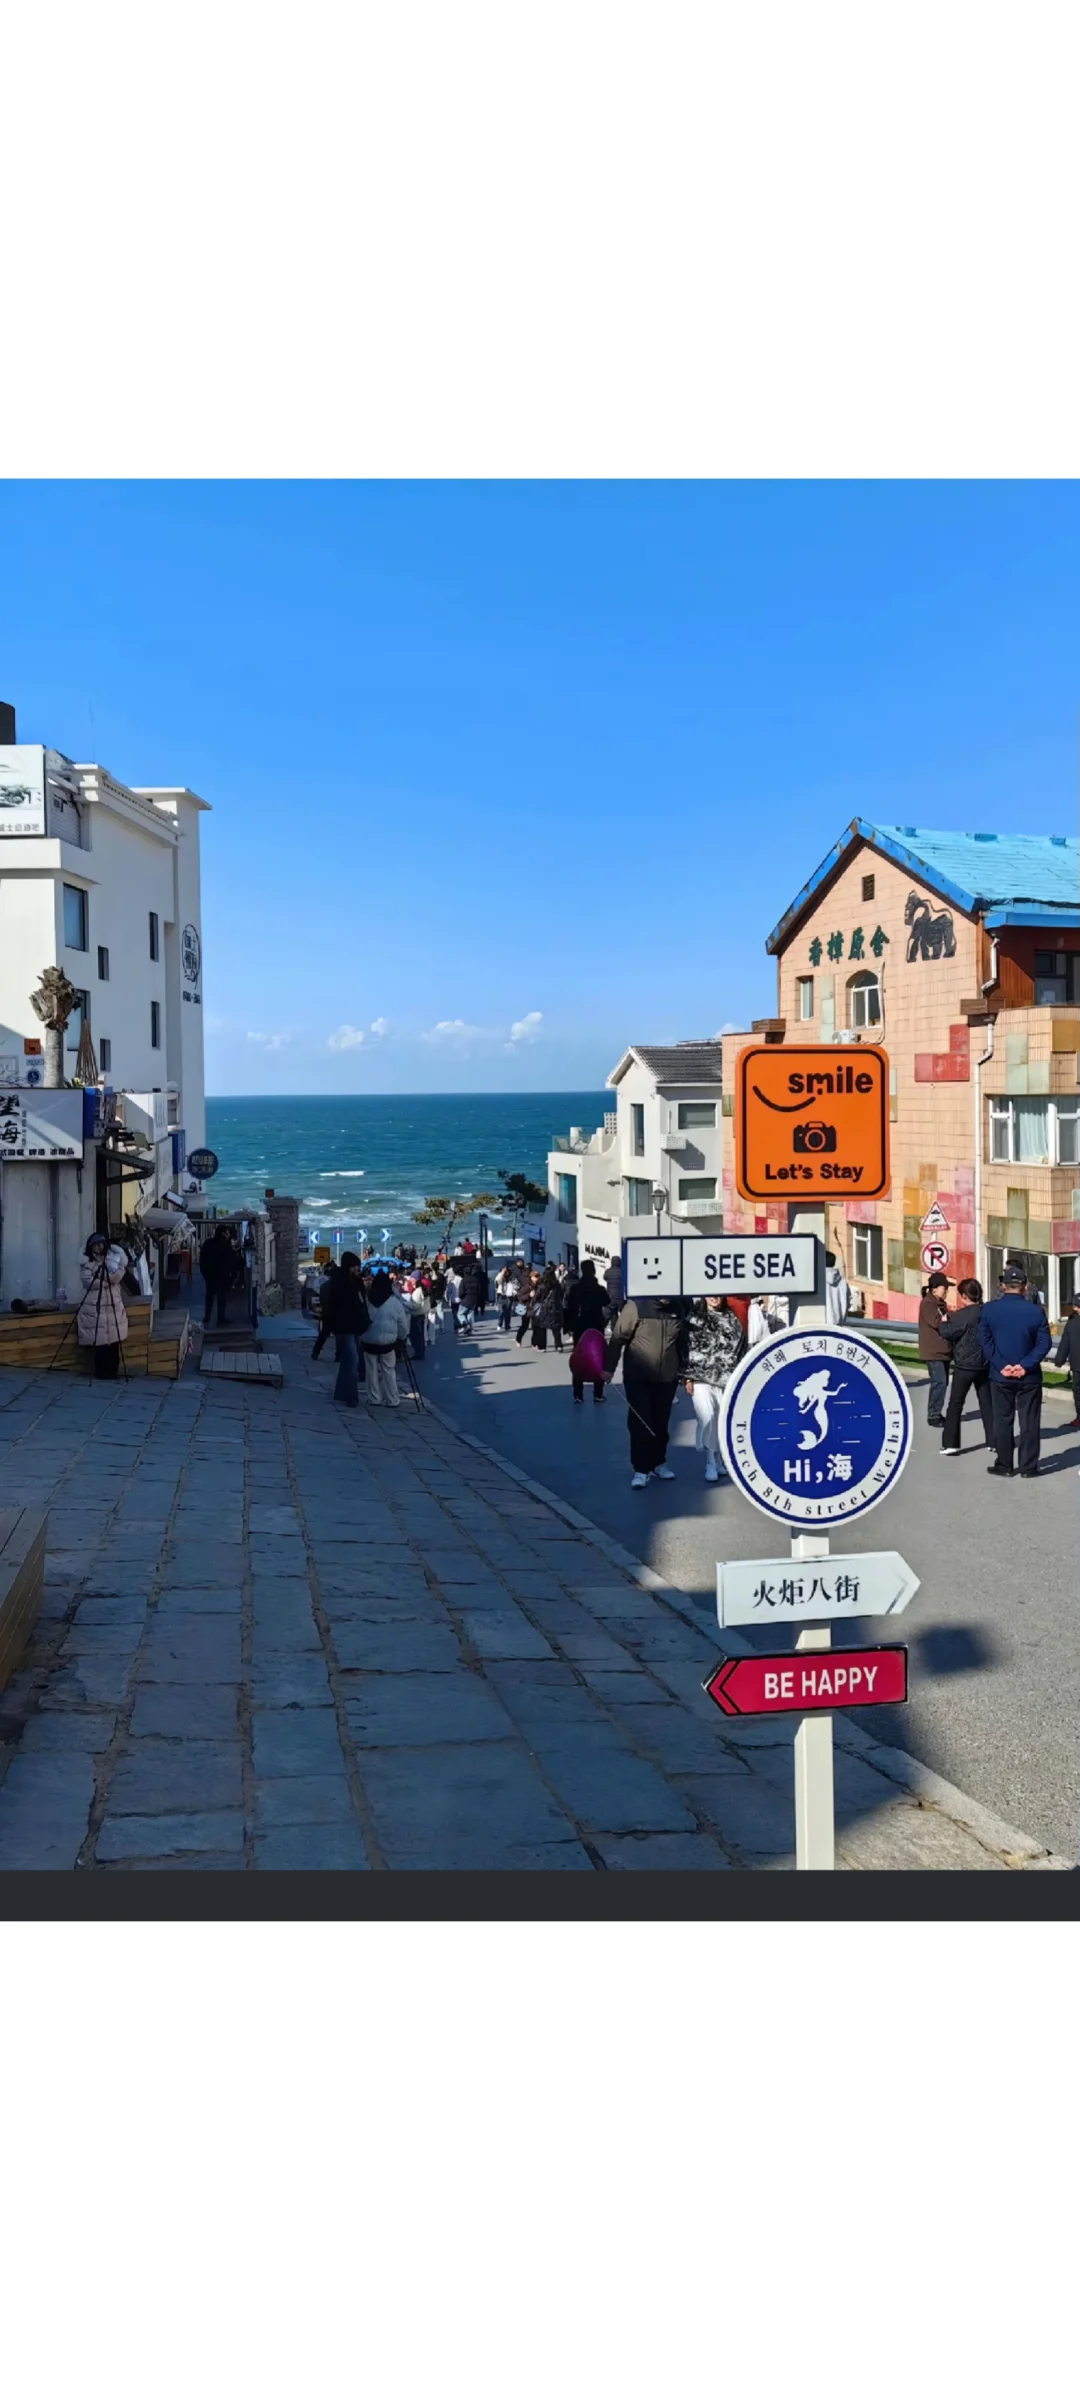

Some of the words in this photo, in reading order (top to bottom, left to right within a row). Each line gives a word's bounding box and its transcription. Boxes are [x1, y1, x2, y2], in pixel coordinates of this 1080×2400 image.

[788, 1065, 873, 1095] smile
[765, 1163, 813, 1180] Let's
[820, 1163, 864, 1183] Stay
[704, 1254, 746, 1280] SEE
[753, 1253, 796, 1278] SEA
[802, 1339, 827, 1354] 토치
[836, 1343, 871, 1368] 8번가
[736, 1421, 758, 1483] Torch
[762, 1486, 792, 1511] 8th
[805, 1489, 868, 1516] street
[873, 1410, 900, 1484] Weihai
[753, 1574, 860, 1608] 火炬八街
[764, 1672, 794, 1699] BE
[801, 1666, 878, 1697] HAPPY
